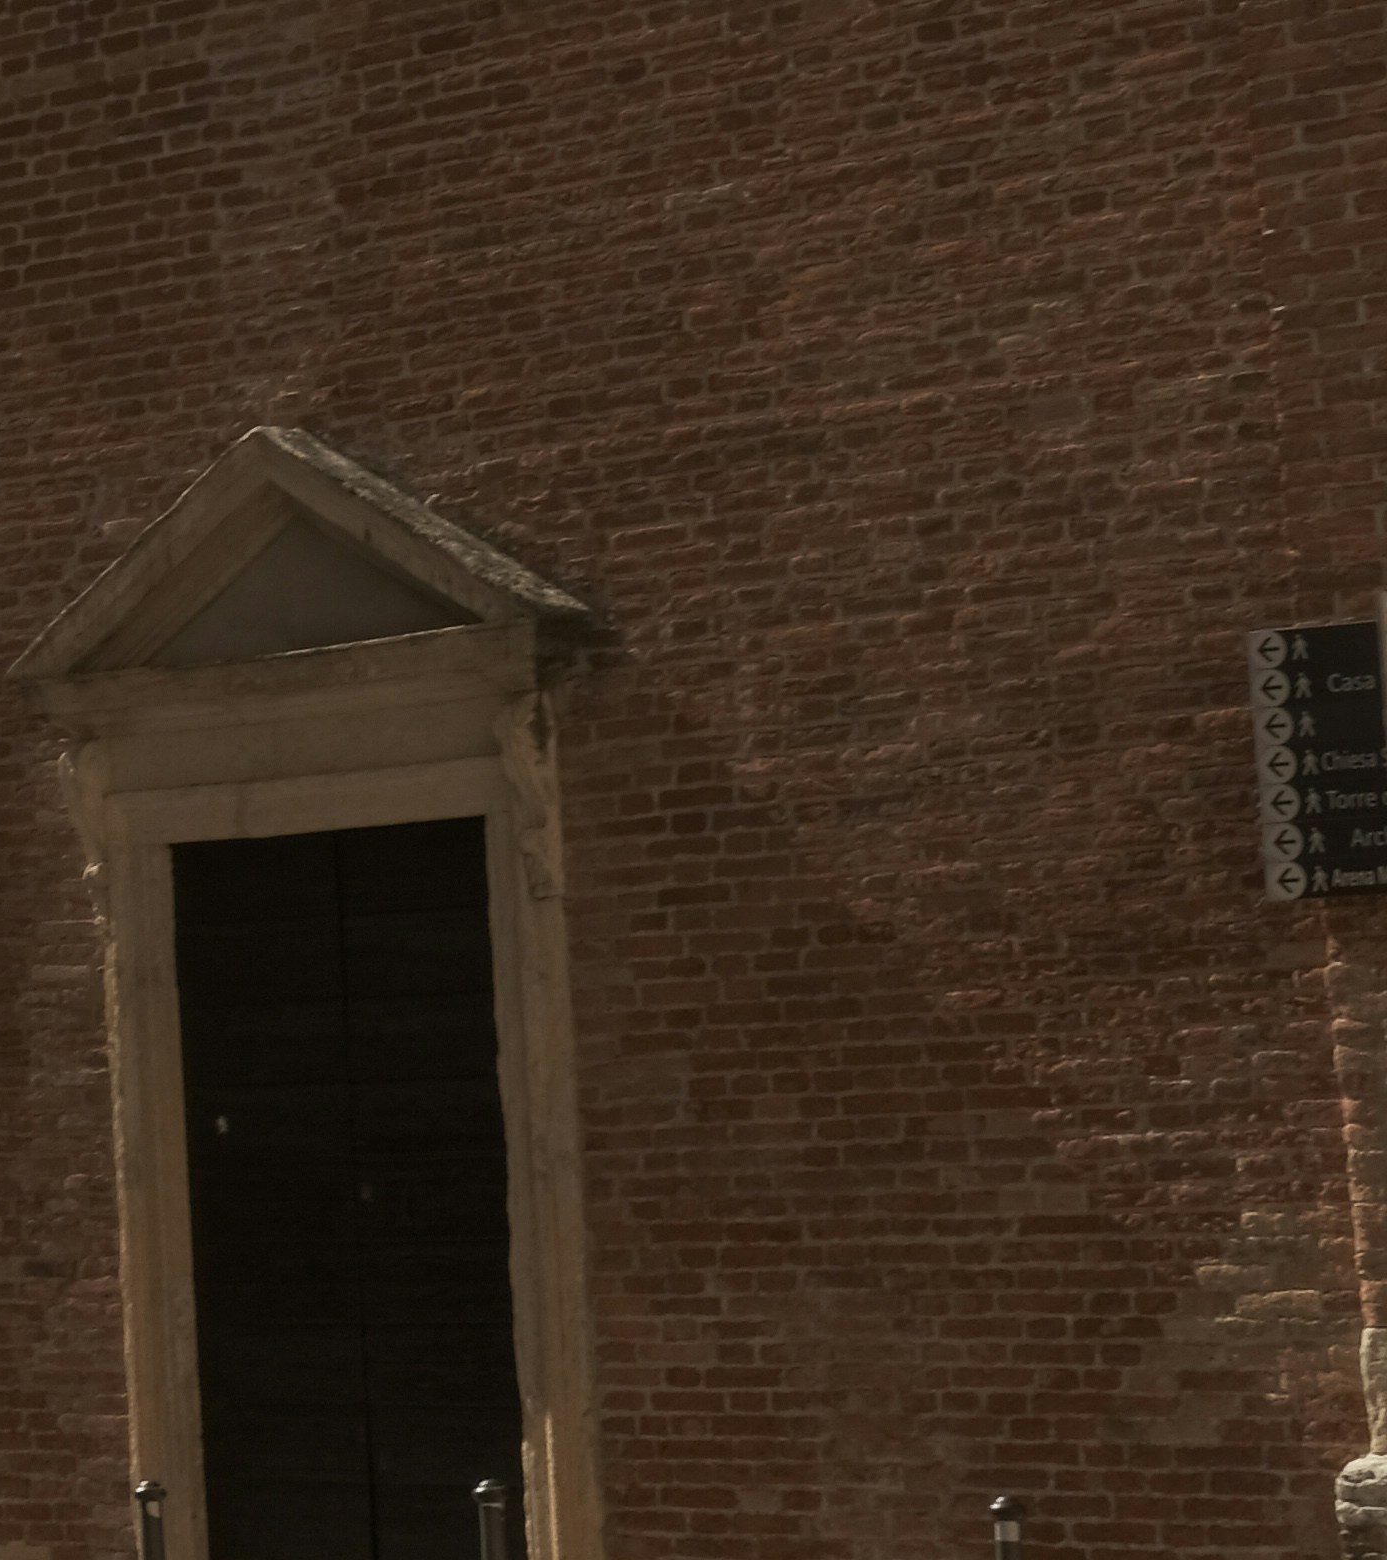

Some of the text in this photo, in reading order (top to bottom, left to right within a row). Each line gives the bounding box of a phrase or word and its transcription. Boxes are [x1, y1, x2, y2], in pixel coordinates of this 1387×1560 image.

[1326, 672, 1376, 693] Casa
[1320, 750, 1378, 771] Chiesa
[1324, 789, 1379, 810] Torre
